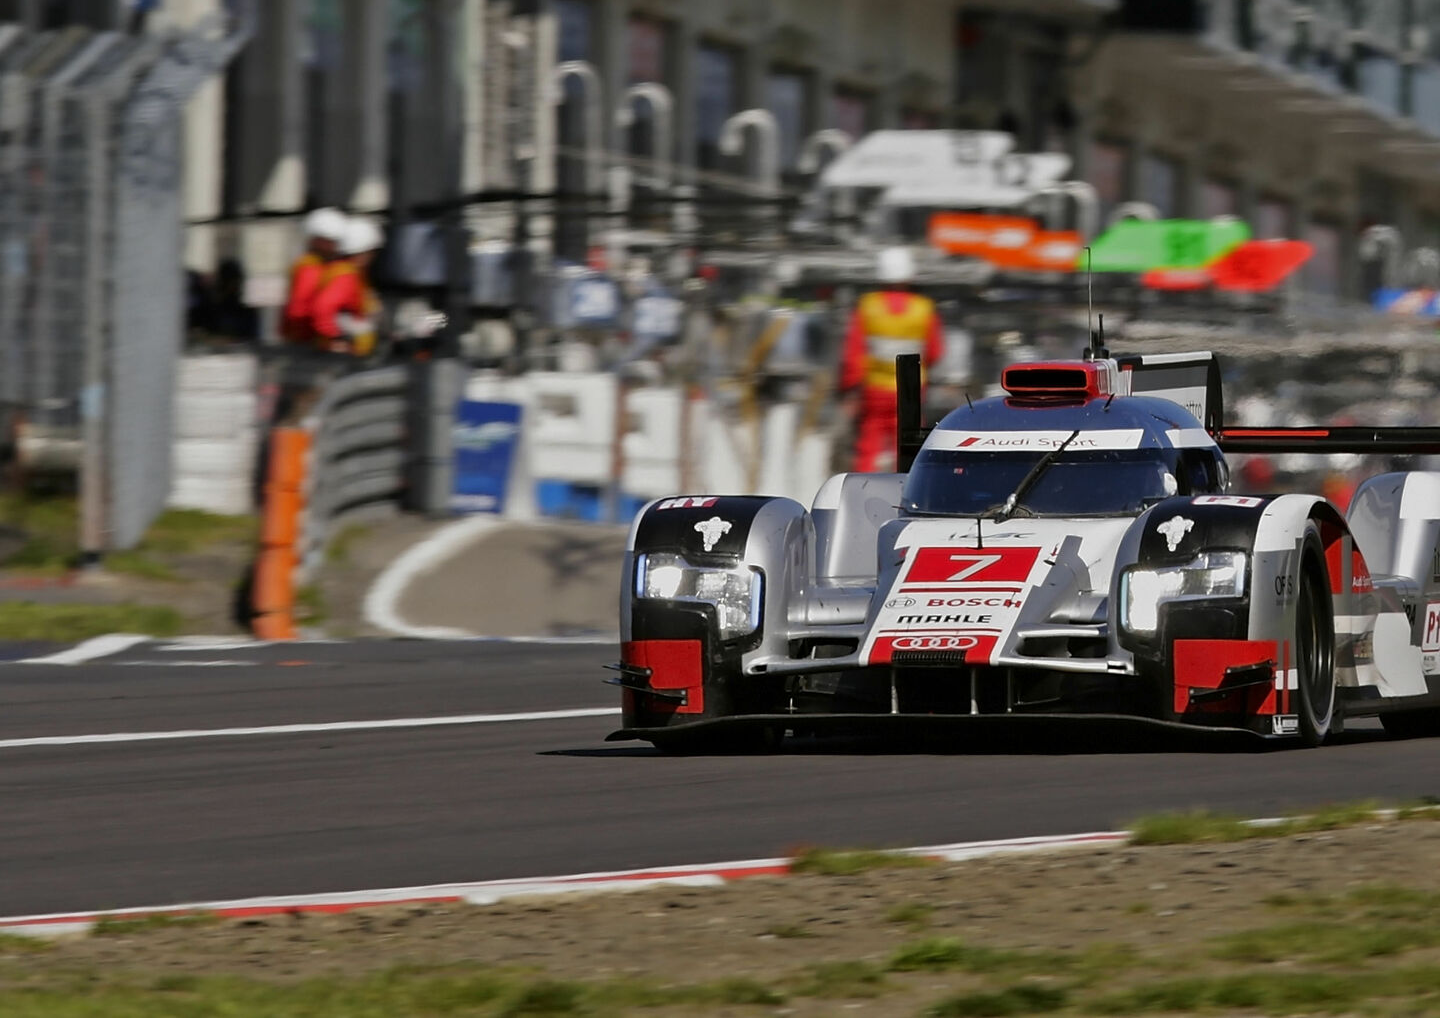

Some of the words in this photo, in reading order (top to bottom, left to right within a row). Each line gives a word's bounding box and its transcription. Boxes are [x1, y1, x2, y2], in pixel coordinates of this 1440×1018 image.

[982, 438, 1030, 446] Audi
[1038, 438, 1097, 448] Sport
[945, 554, 1002, 581] 7
[926, 598, 1022, 608] BOSCH
[897, 614, 993, 624] MAHLE
